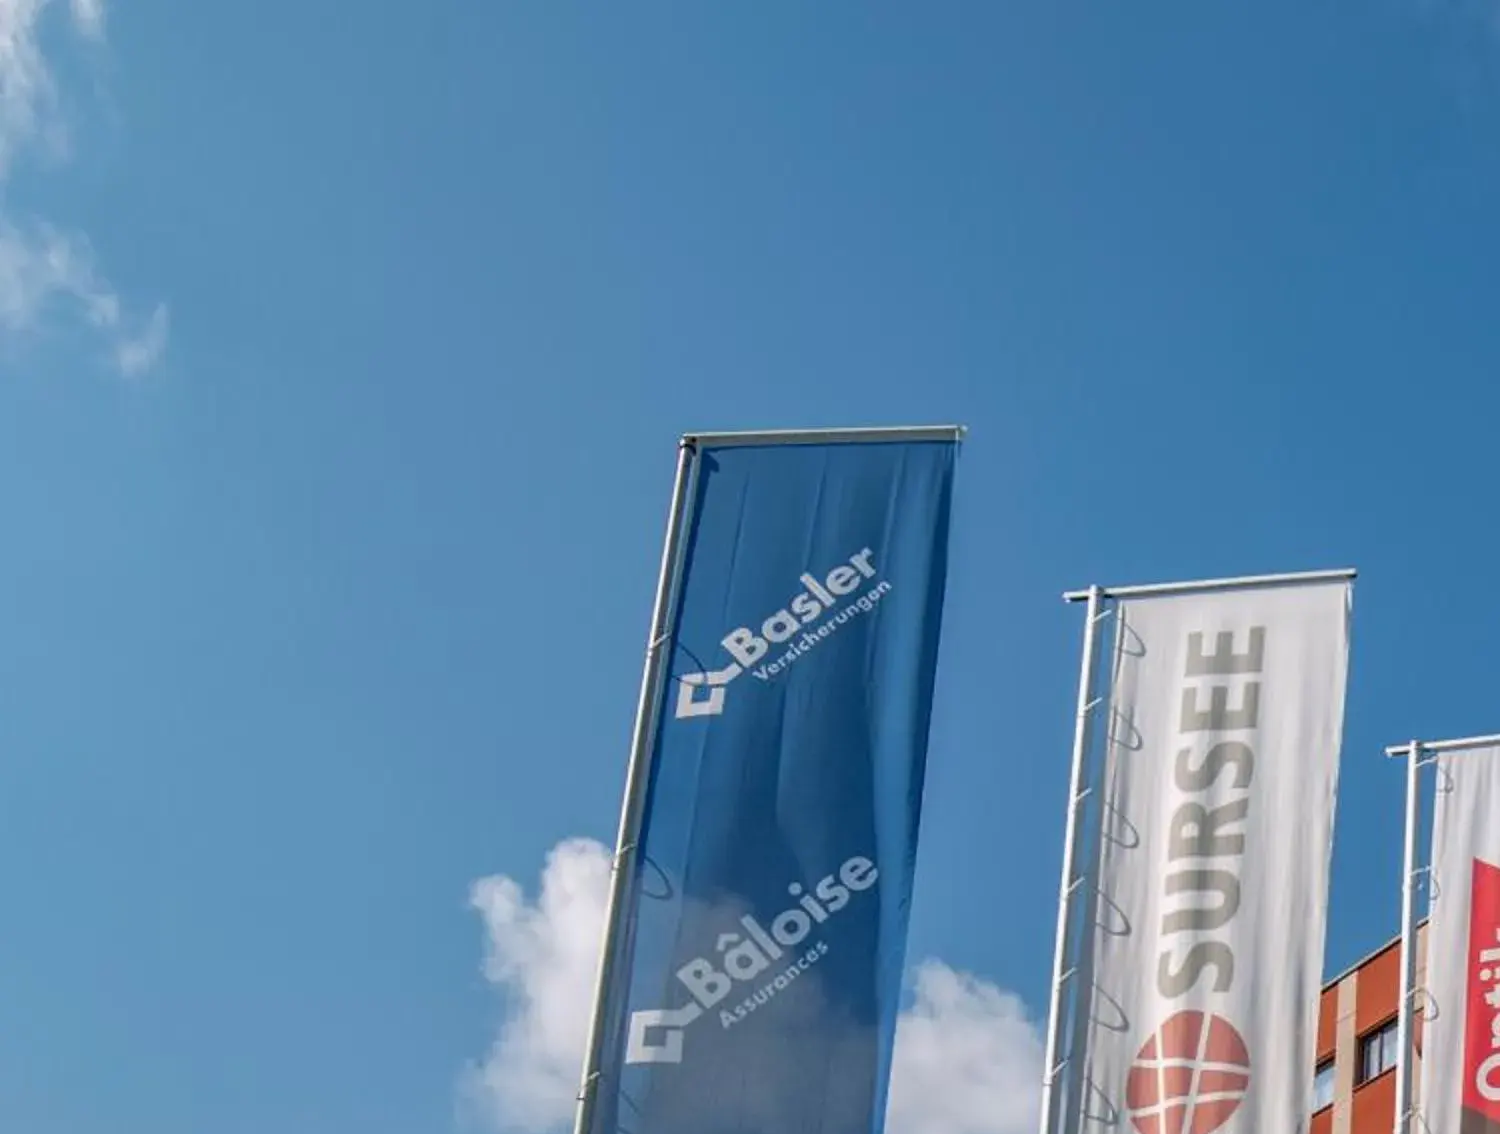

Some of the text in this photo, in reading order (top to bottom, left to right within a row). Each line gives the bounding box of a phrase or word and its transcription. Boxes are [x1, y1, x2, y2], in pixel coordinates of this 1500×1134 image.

[721, 546, 878, 668] Basler
[752, 578, 892, 683] Versicherungen
[1157, 625, 1267, 999] SURSEE
[676, 854, 879, 1011] Bâloise
[718, 939, 829, 1030] Assurances
